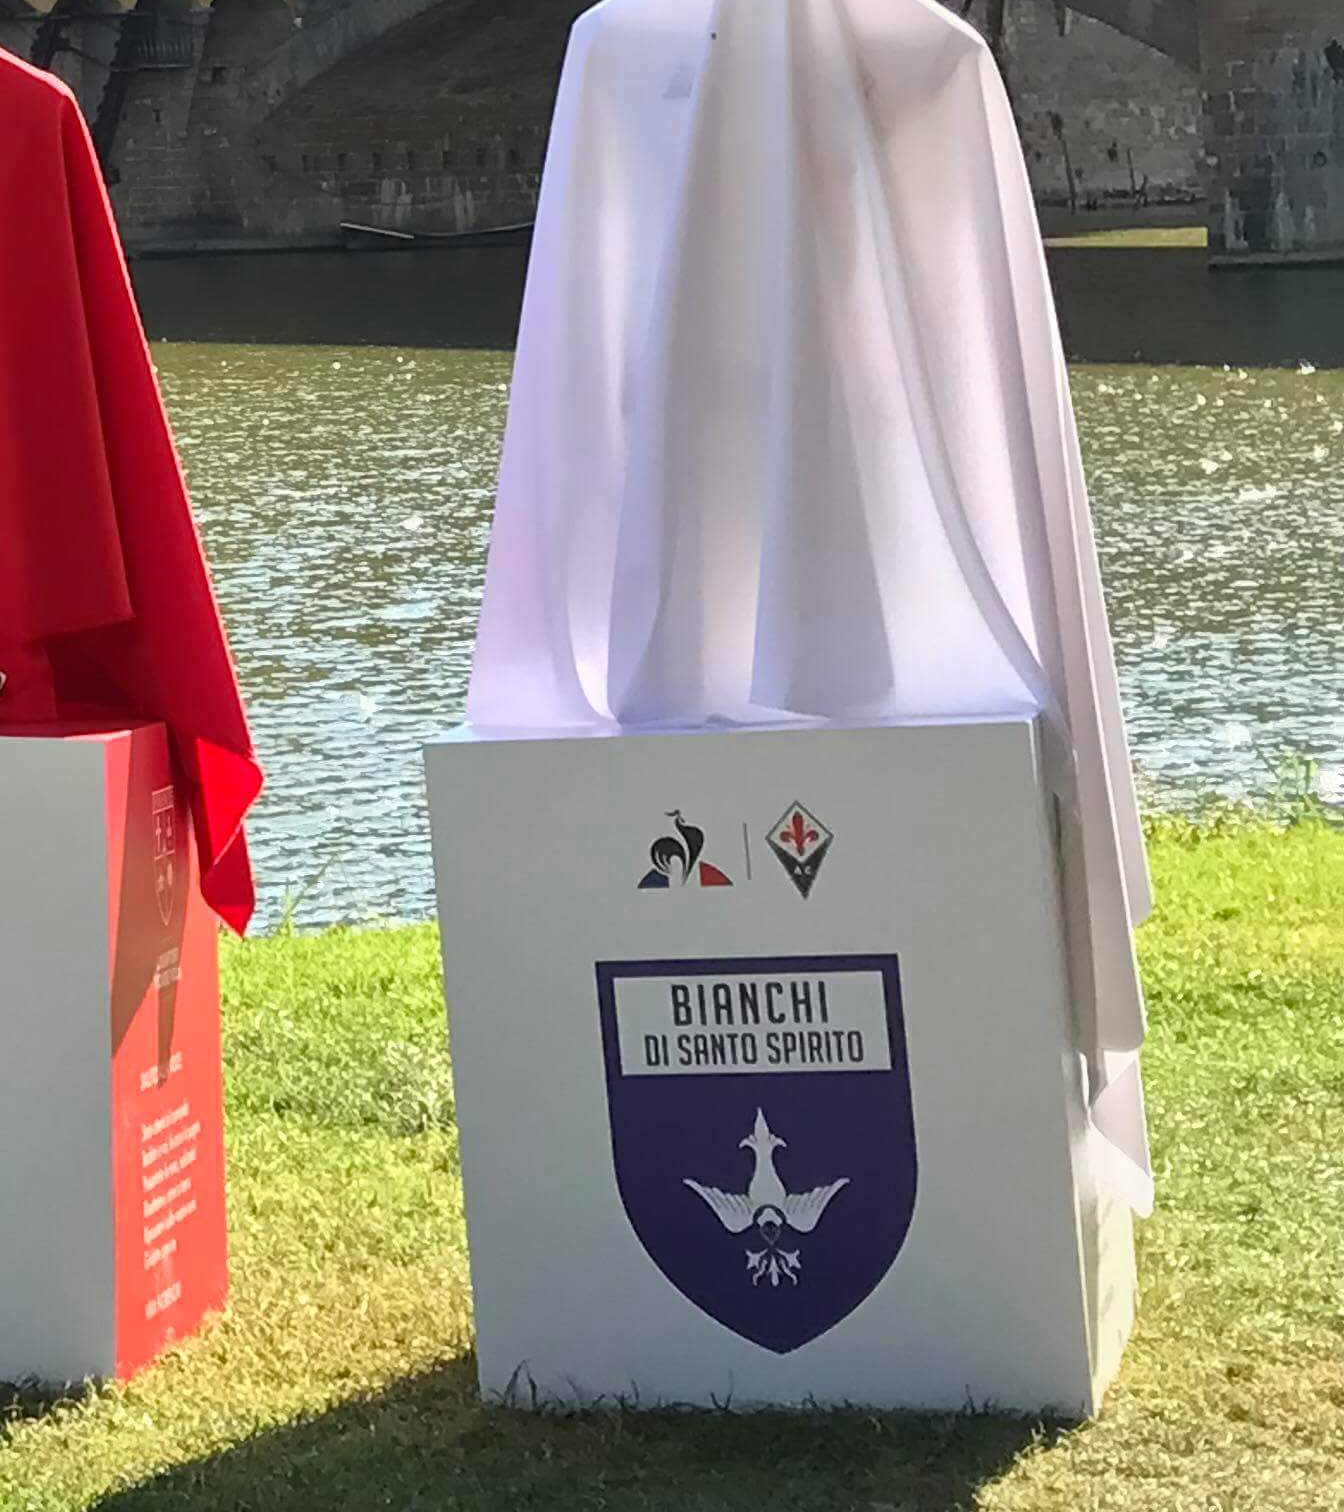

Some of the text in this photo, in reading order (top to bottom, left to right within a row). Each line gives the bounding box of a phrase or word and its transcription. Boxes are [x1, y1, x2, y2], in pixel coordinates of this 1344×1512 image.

[671, 980, 829, 1027] BIANCHI
[644, 1030, 864, 1067] DI SANTO SPIRITO
